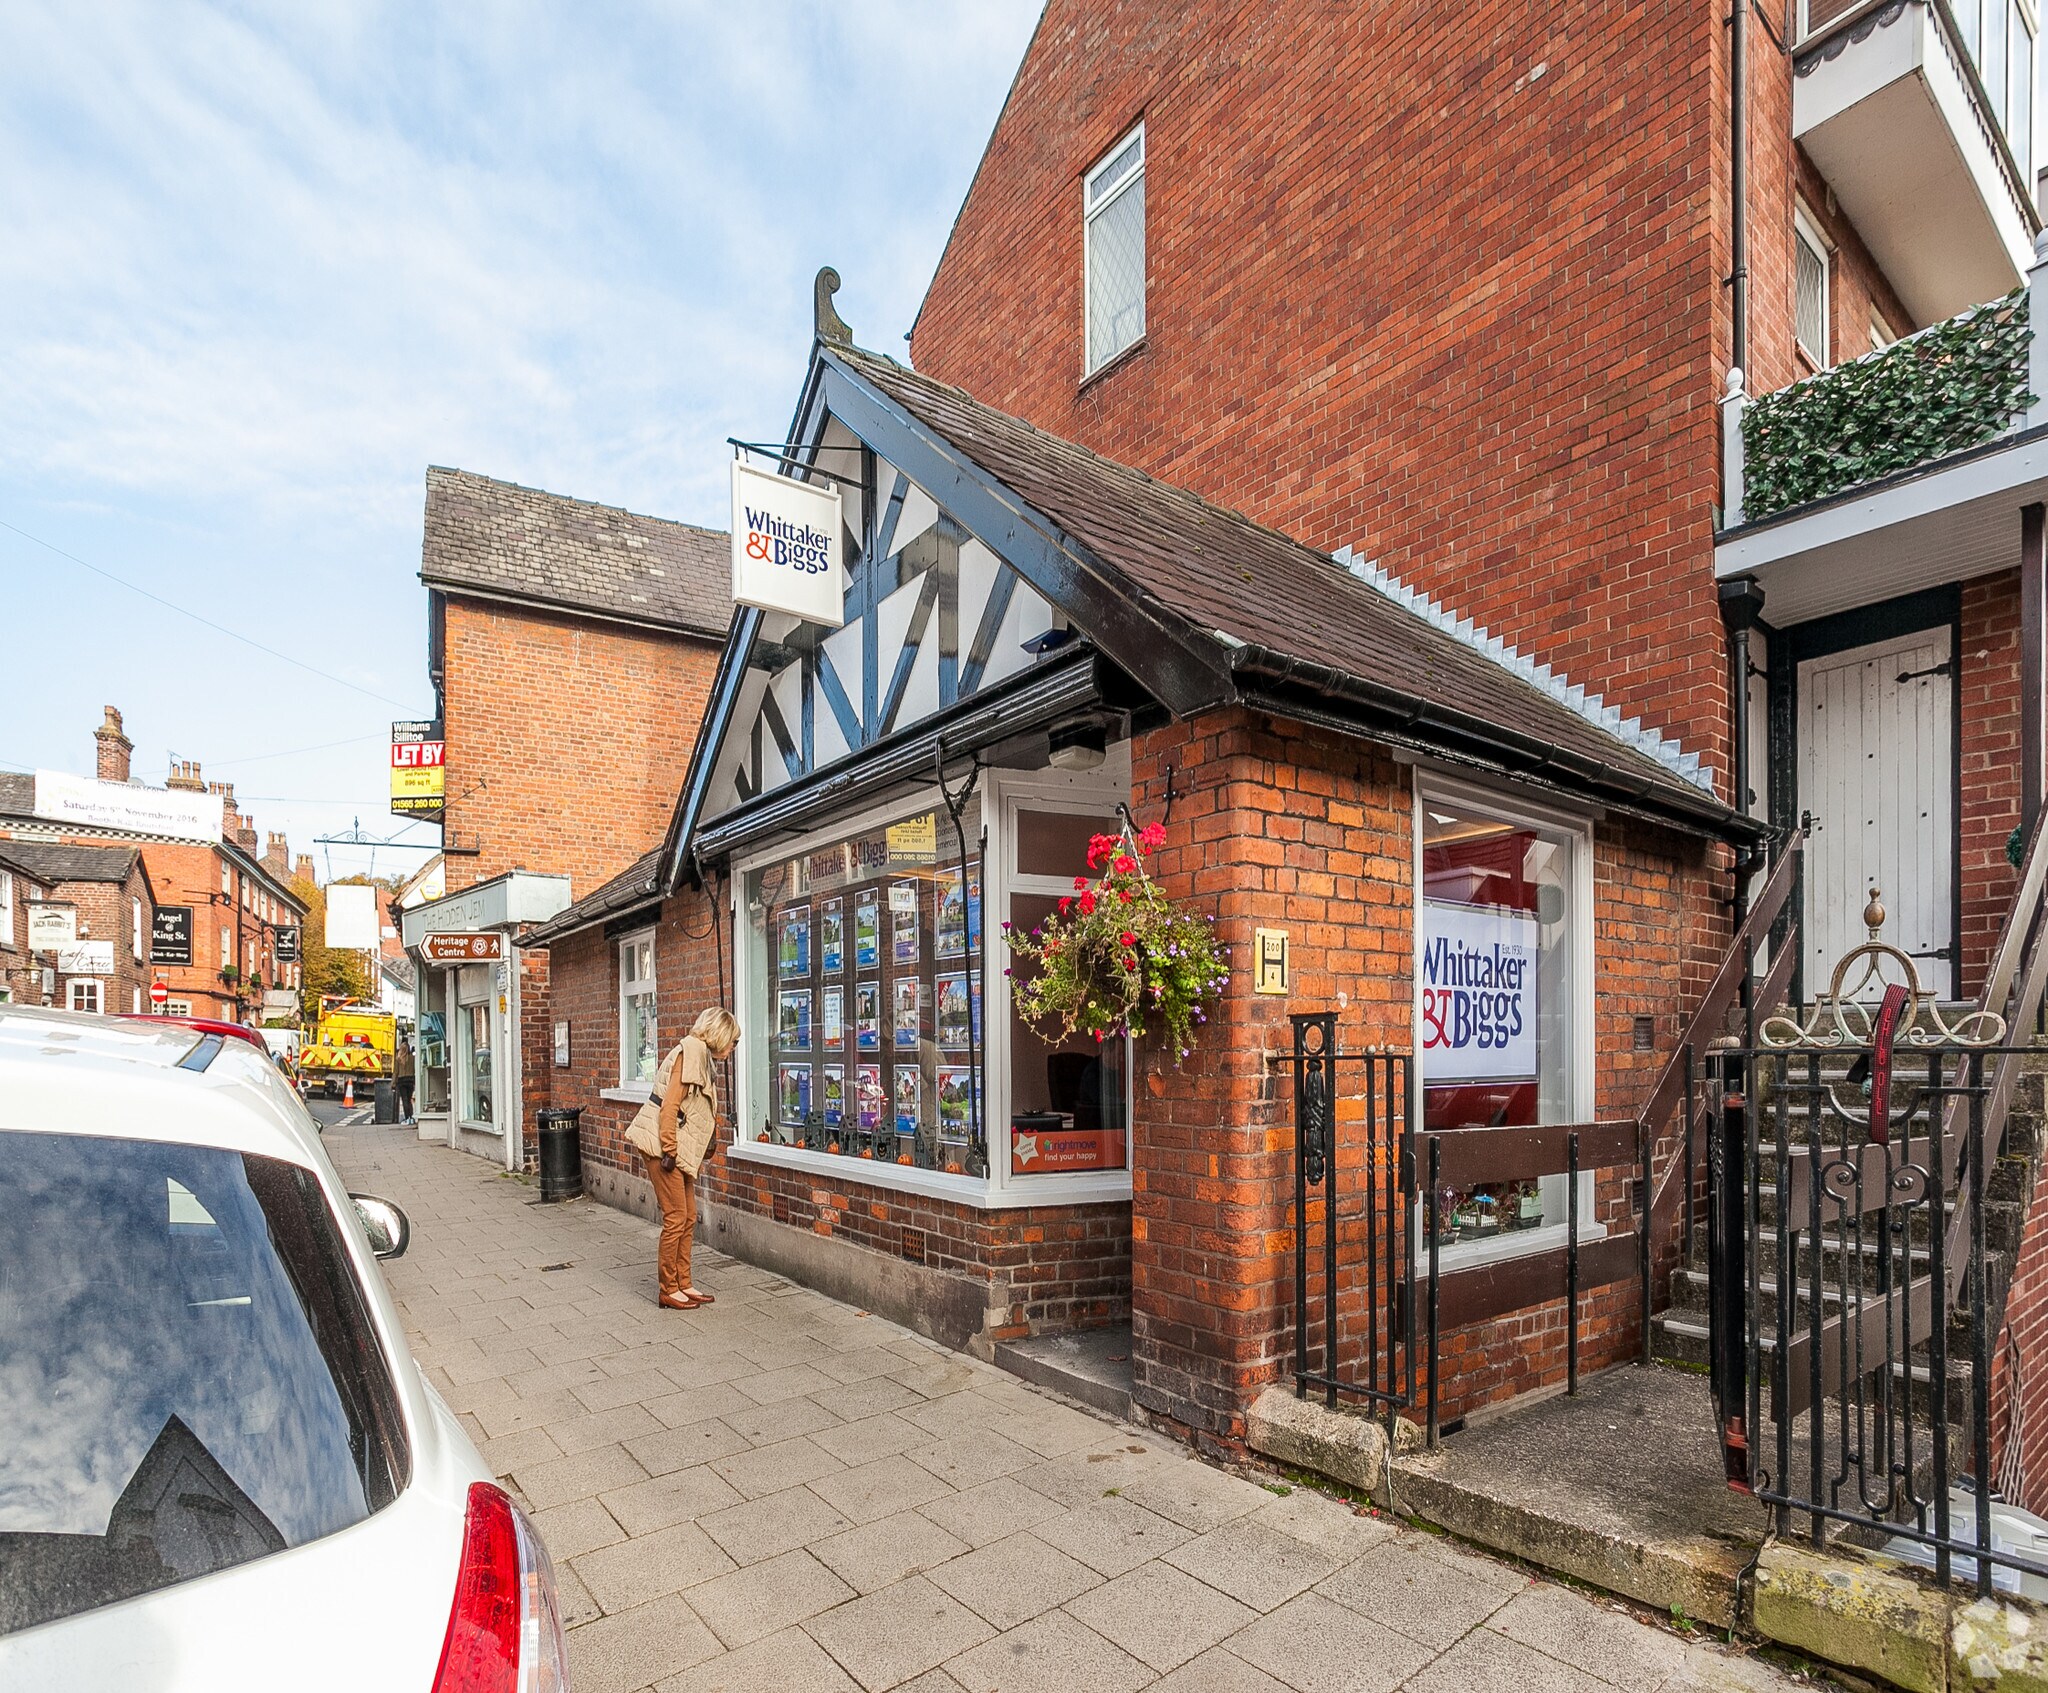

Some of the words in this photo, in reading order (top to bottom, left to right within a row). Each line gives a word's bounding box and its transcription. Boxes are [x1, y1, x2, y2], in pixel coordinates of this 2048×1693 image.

[744, 505, 832, 551] Whittaker
[746, 531, 773, 563] &
[774, 538, 829, 575] Biggs
[393, 722, 431, 732] Williams
[393, 732, 424, 742] Sillitoe
[393, 744, 420, 766] LET
[422, 743, 444, 765] BY
[63, 799, 108, 813] Saturday
[125, 807, 173, 821] November
[176, 814, 198, 823] 2016
[864, 840, 887, 868] Bigg
[156, 912, 183, 924] Angel
[152, 930, 174, 942] King
[175, 931, 187, 941] St.
[433, 936, 469, 947] Heritage
[437, 949, 466, 957] Centre
[1266, 942, 1280, 952] 200
[1511, 944, 1522, 956] 1930
[1453, 990, 1522, 1049] Biggs
[1053, 1140, 1097, 1153] rightmove
[1044, 1152, 1058, 1161] find
[1059, 1152, 1075, 1162] your
[1076, 1152, 1097, 1160] happy
